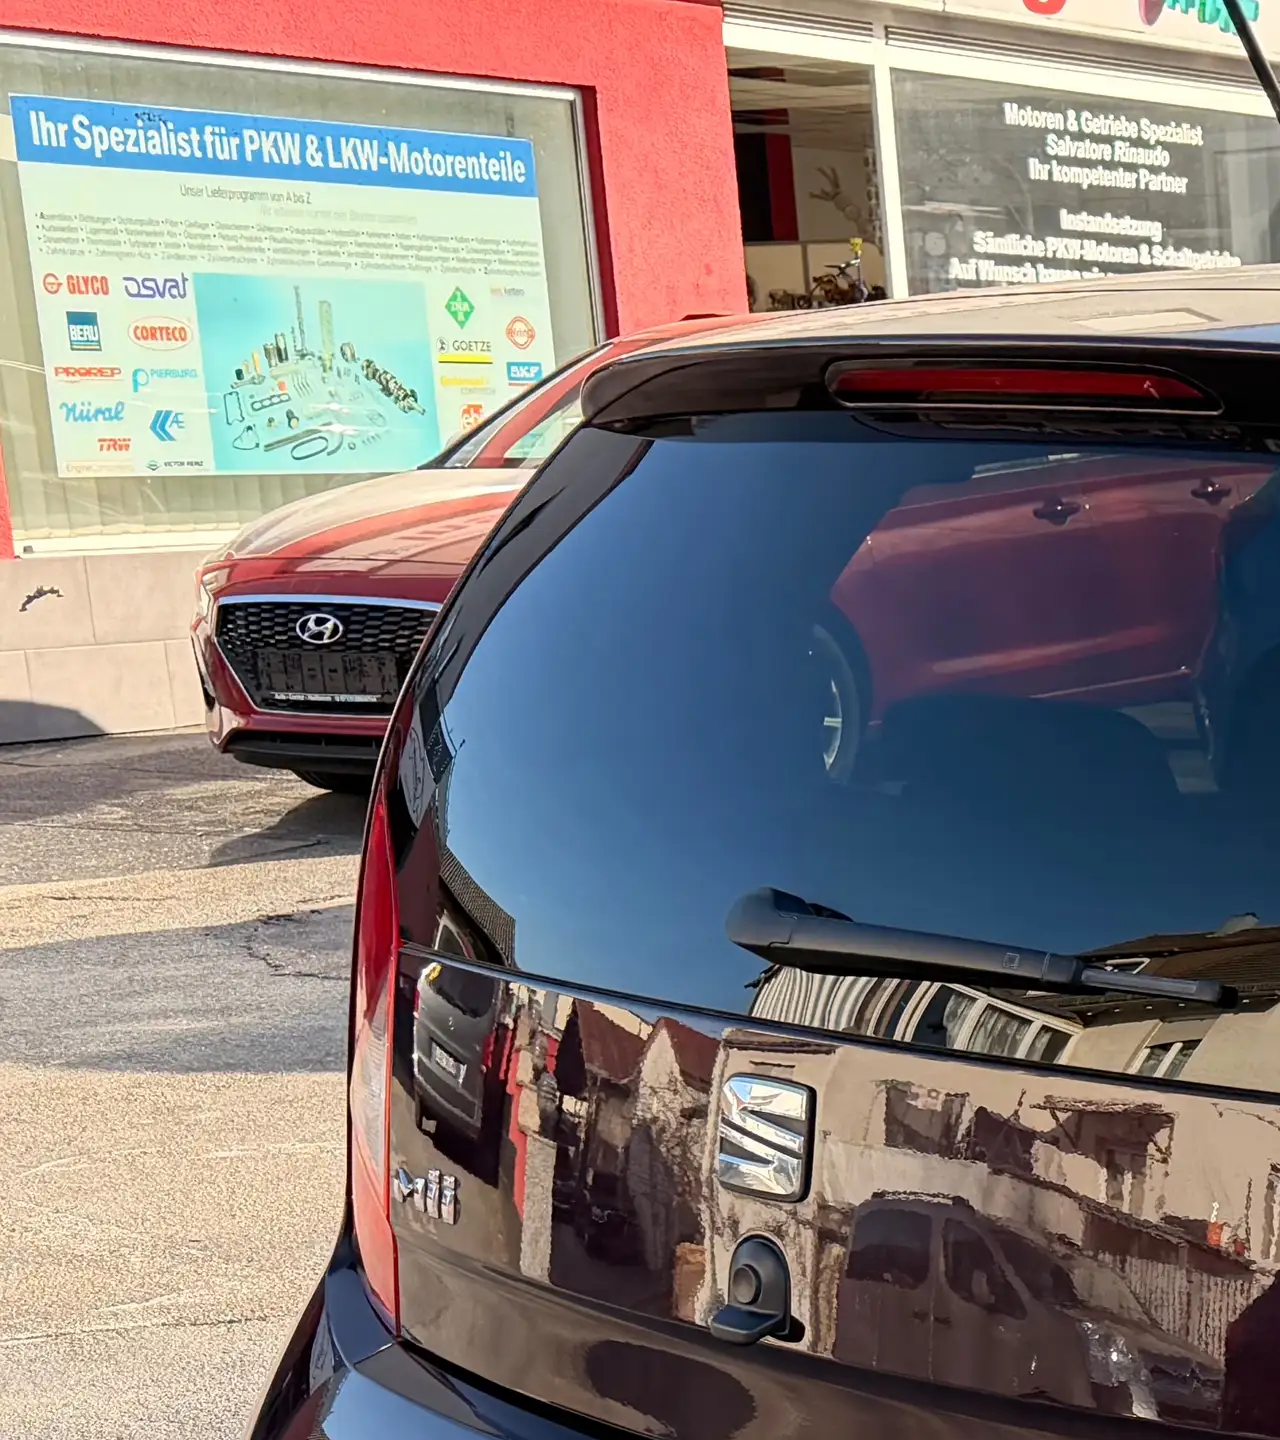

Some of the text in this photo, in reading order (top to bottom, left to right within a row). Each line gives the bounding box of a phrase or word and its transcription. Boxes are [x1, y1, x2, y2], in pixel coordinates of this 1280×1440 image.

[1003, 102, 1204, 146] Motoren & Getriebe Spezialist
[29, 110, 526, 183] Ihr Spezialist für PKW & LKW-Motorenteile
[1045, 133, 1170, 167] Salvatore Rinaudo
[1028, 158, 1188, 194] Ihr kompetenter Partner
[180, 184, 204, 197] Unser
[1060, 208, 1162, 242] Instandsetzung
[973, 230, 1045, 257] Sämtliche
[949, 257, 977, 280] Auf
[979, 259, 1036, 283] Wunsch
[66, 275, 110, 296] GLYCO
[133, 325, 188, 342] CORTECO
[452, 340, 492, 352] GOETZE
